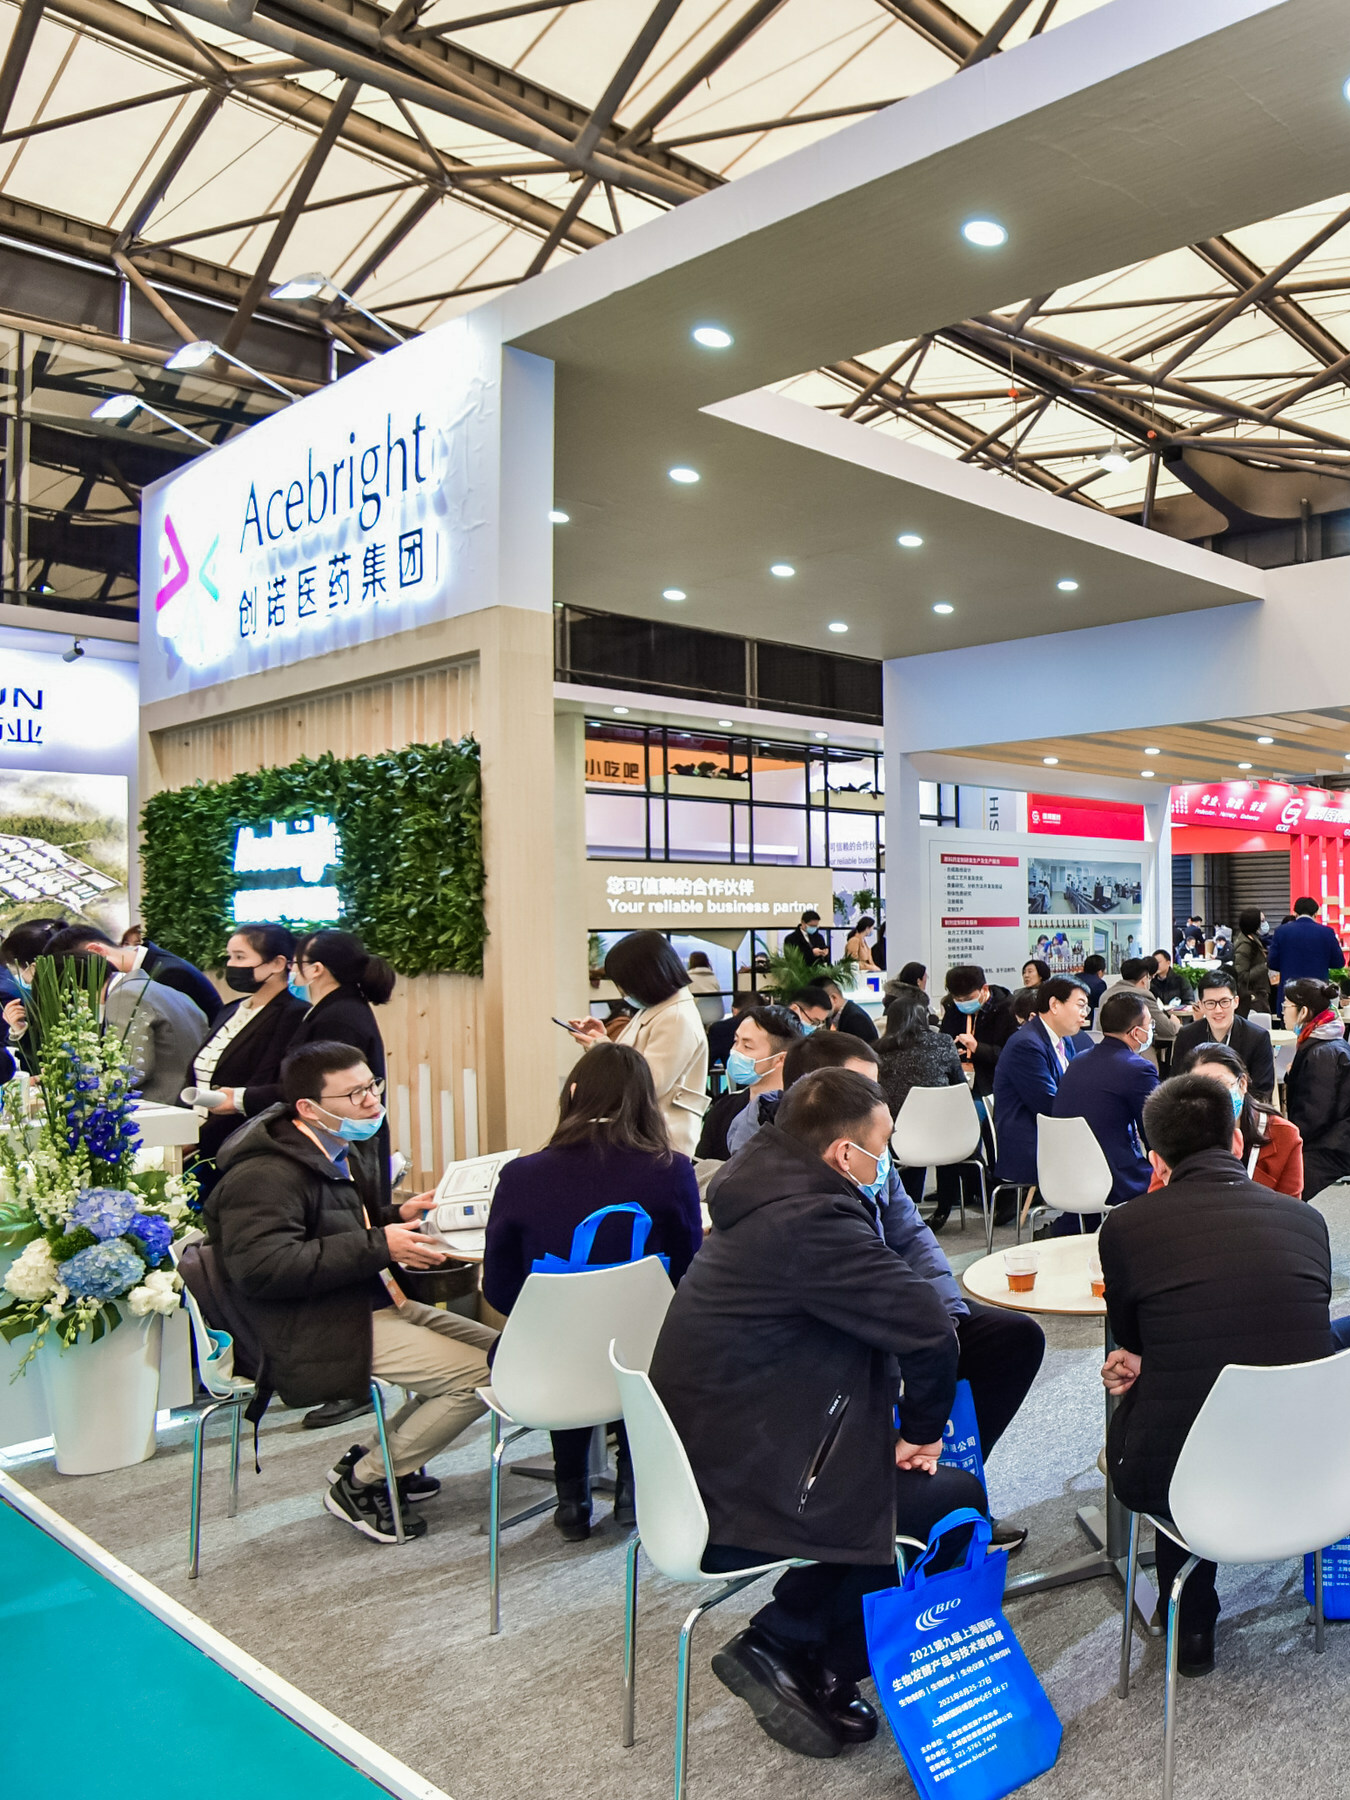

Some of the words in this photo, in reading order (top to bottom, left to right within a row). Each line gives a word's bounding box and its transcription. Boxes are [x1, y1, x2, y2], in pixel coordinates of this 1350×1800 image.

[240, 413, 427, 554] Acebright
[239, 527, 424, 638] 创诺医药集团
[0, 687, 43, 710] N
[0, 717, 43, 744] 业
[585, 758, 640, 779] 小吃吧
[607, 876, 754, 896] 您可信赖的合作伙伴
[607, 900, 644, 913] Your
[648, 900, 703, 913] reliable
[707, 900, 770, 913] business
[773, 901, 819, 915] partner
[935, 1598, 961, 1615] BIO
[909, 1617, 996, 1663] 2021第九届上海国际
[892, 1630, 1005, 1692] 生物发酵产品与技术装备展
[930, 1673, 956, 1691] 生物技术
[960, 1660, 985, 1677] 生化仪器
[938, 1676, 992, 1708] 2021年8月25-27日
[954, 1741, 982, 1759] 021-5761
